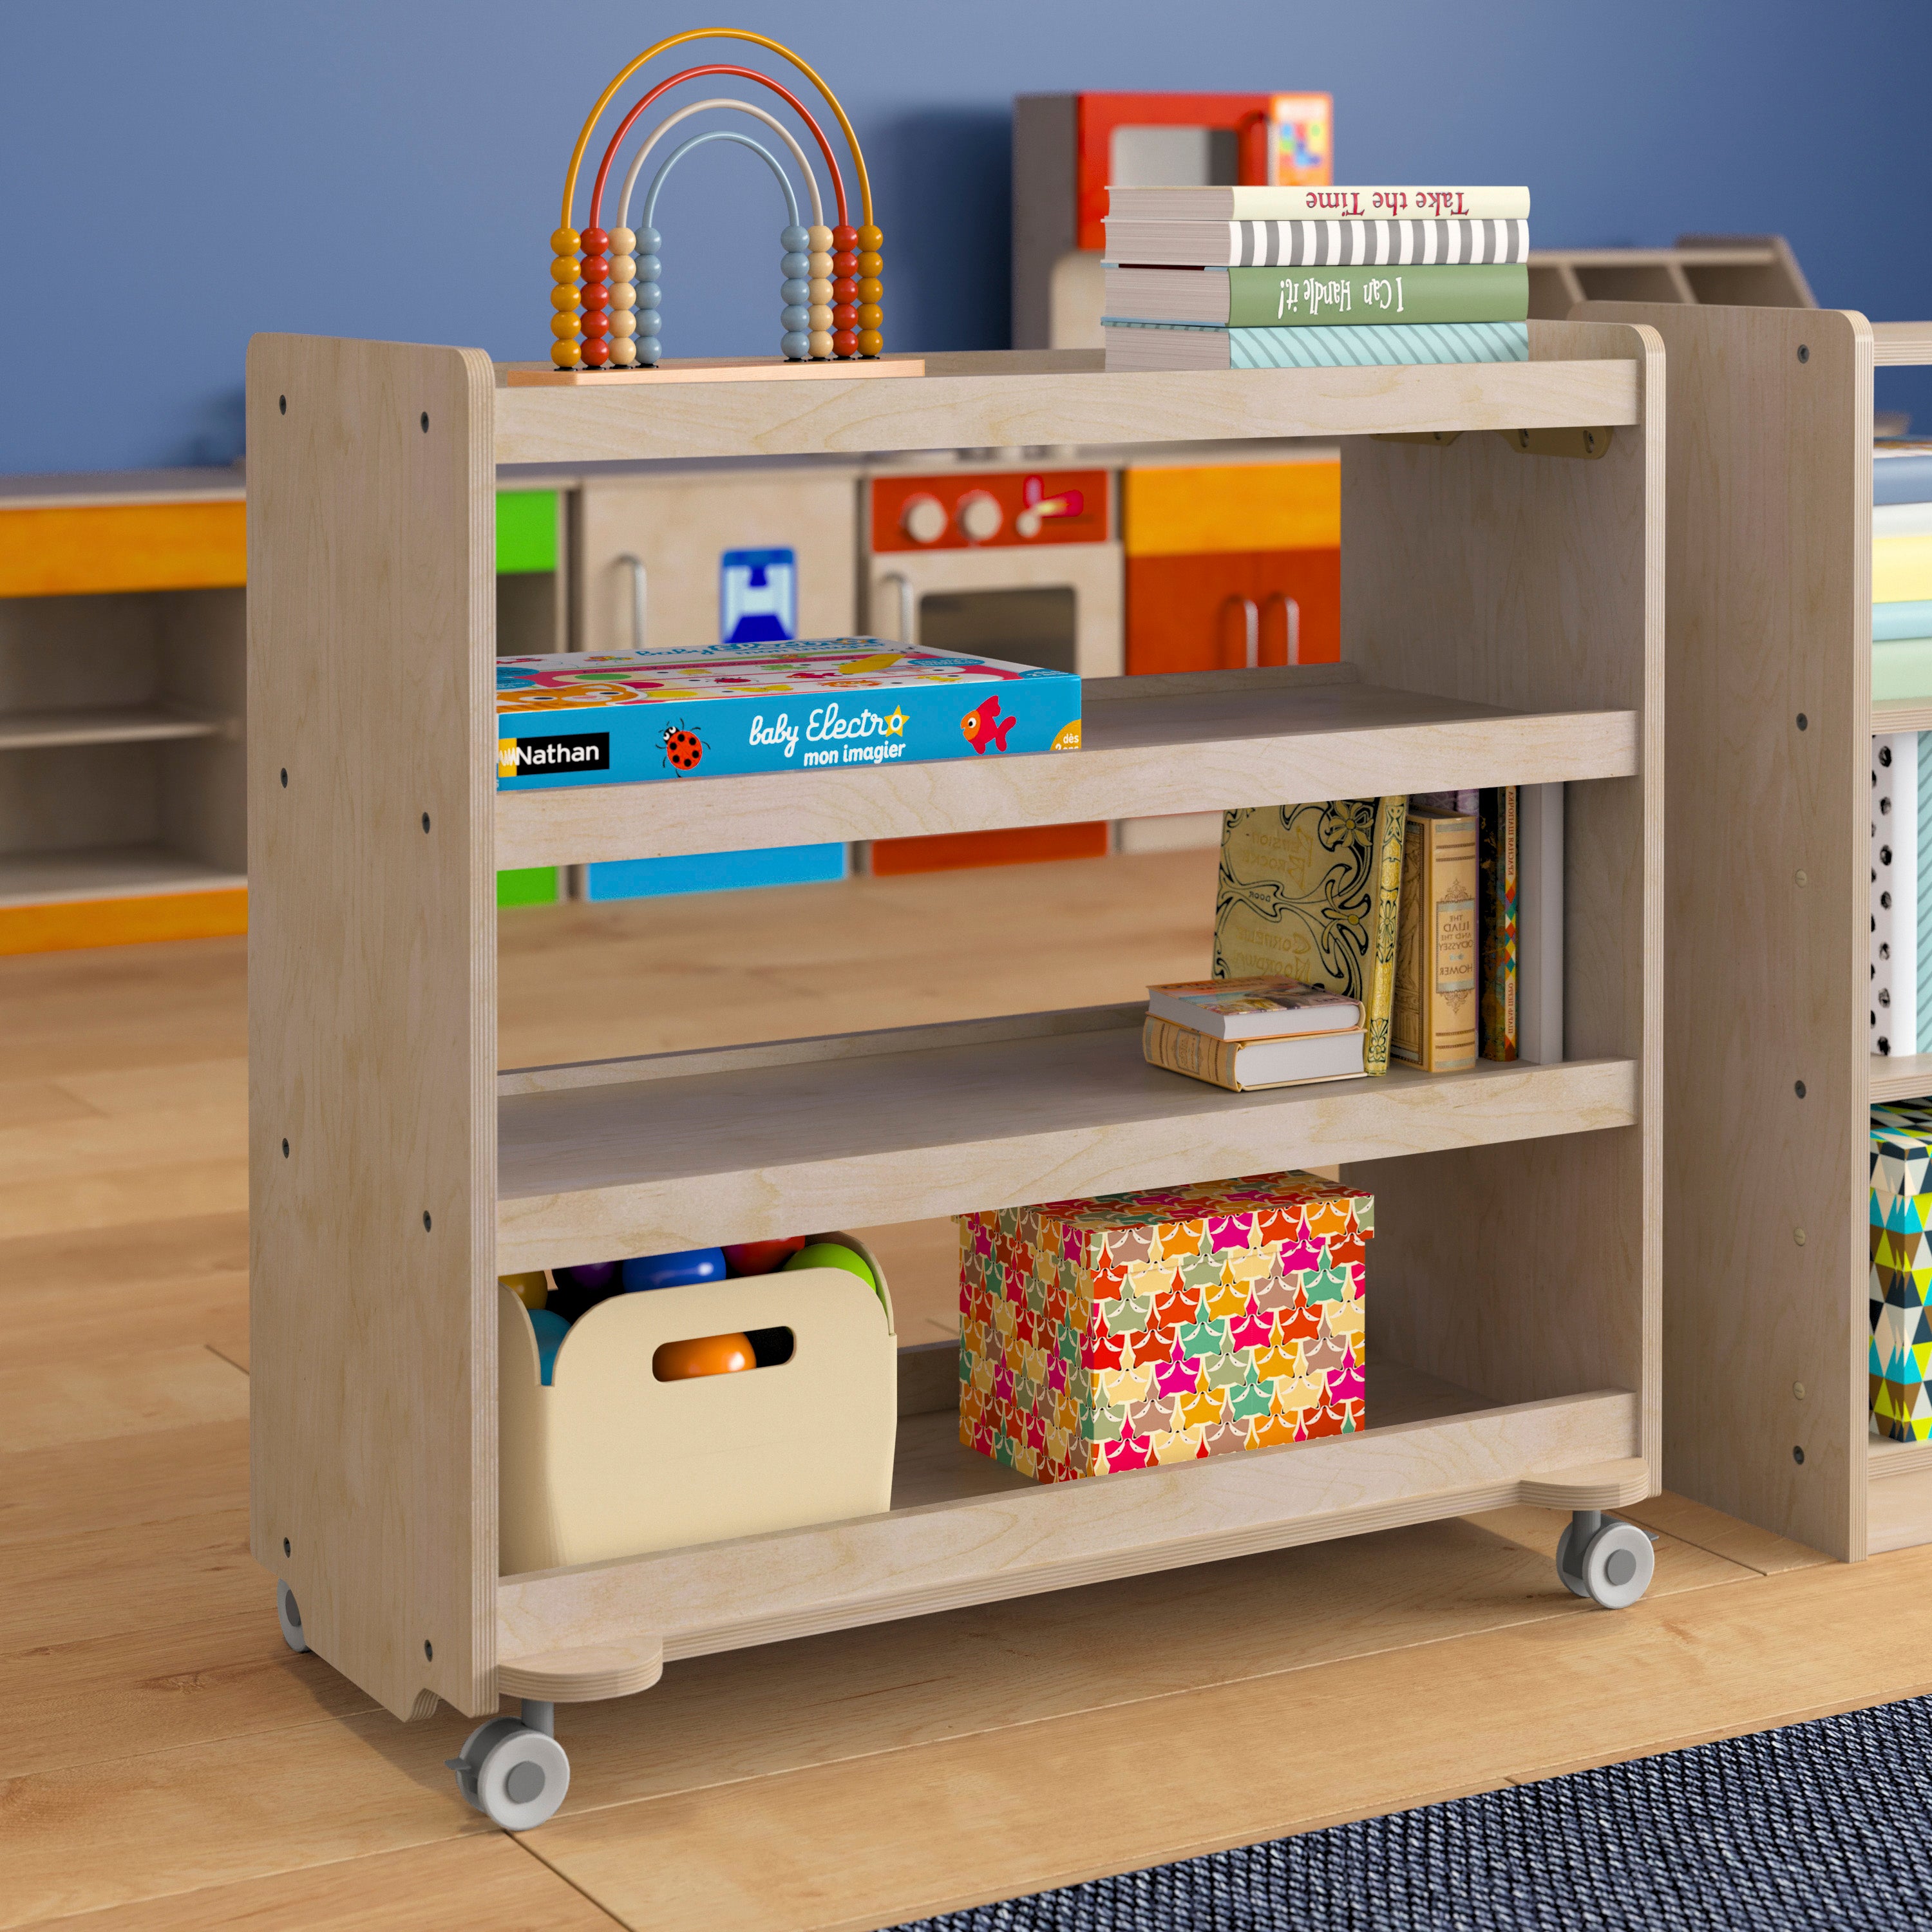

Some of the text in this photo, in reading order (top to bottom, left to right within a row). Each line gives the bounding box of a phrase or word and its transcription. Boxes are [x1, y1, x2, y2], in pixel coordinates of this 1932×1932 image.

[1306, 192, 1470, 216] Take the Time
[1278, 276, 1405, 319] I Can Handle it!
[749, 702, 903, 758] baby Electro
[1063, 733, 1079, 744] dès
[516, 743, 600, 766] Nathan
[804, 741, 906, 766] mon imagier
